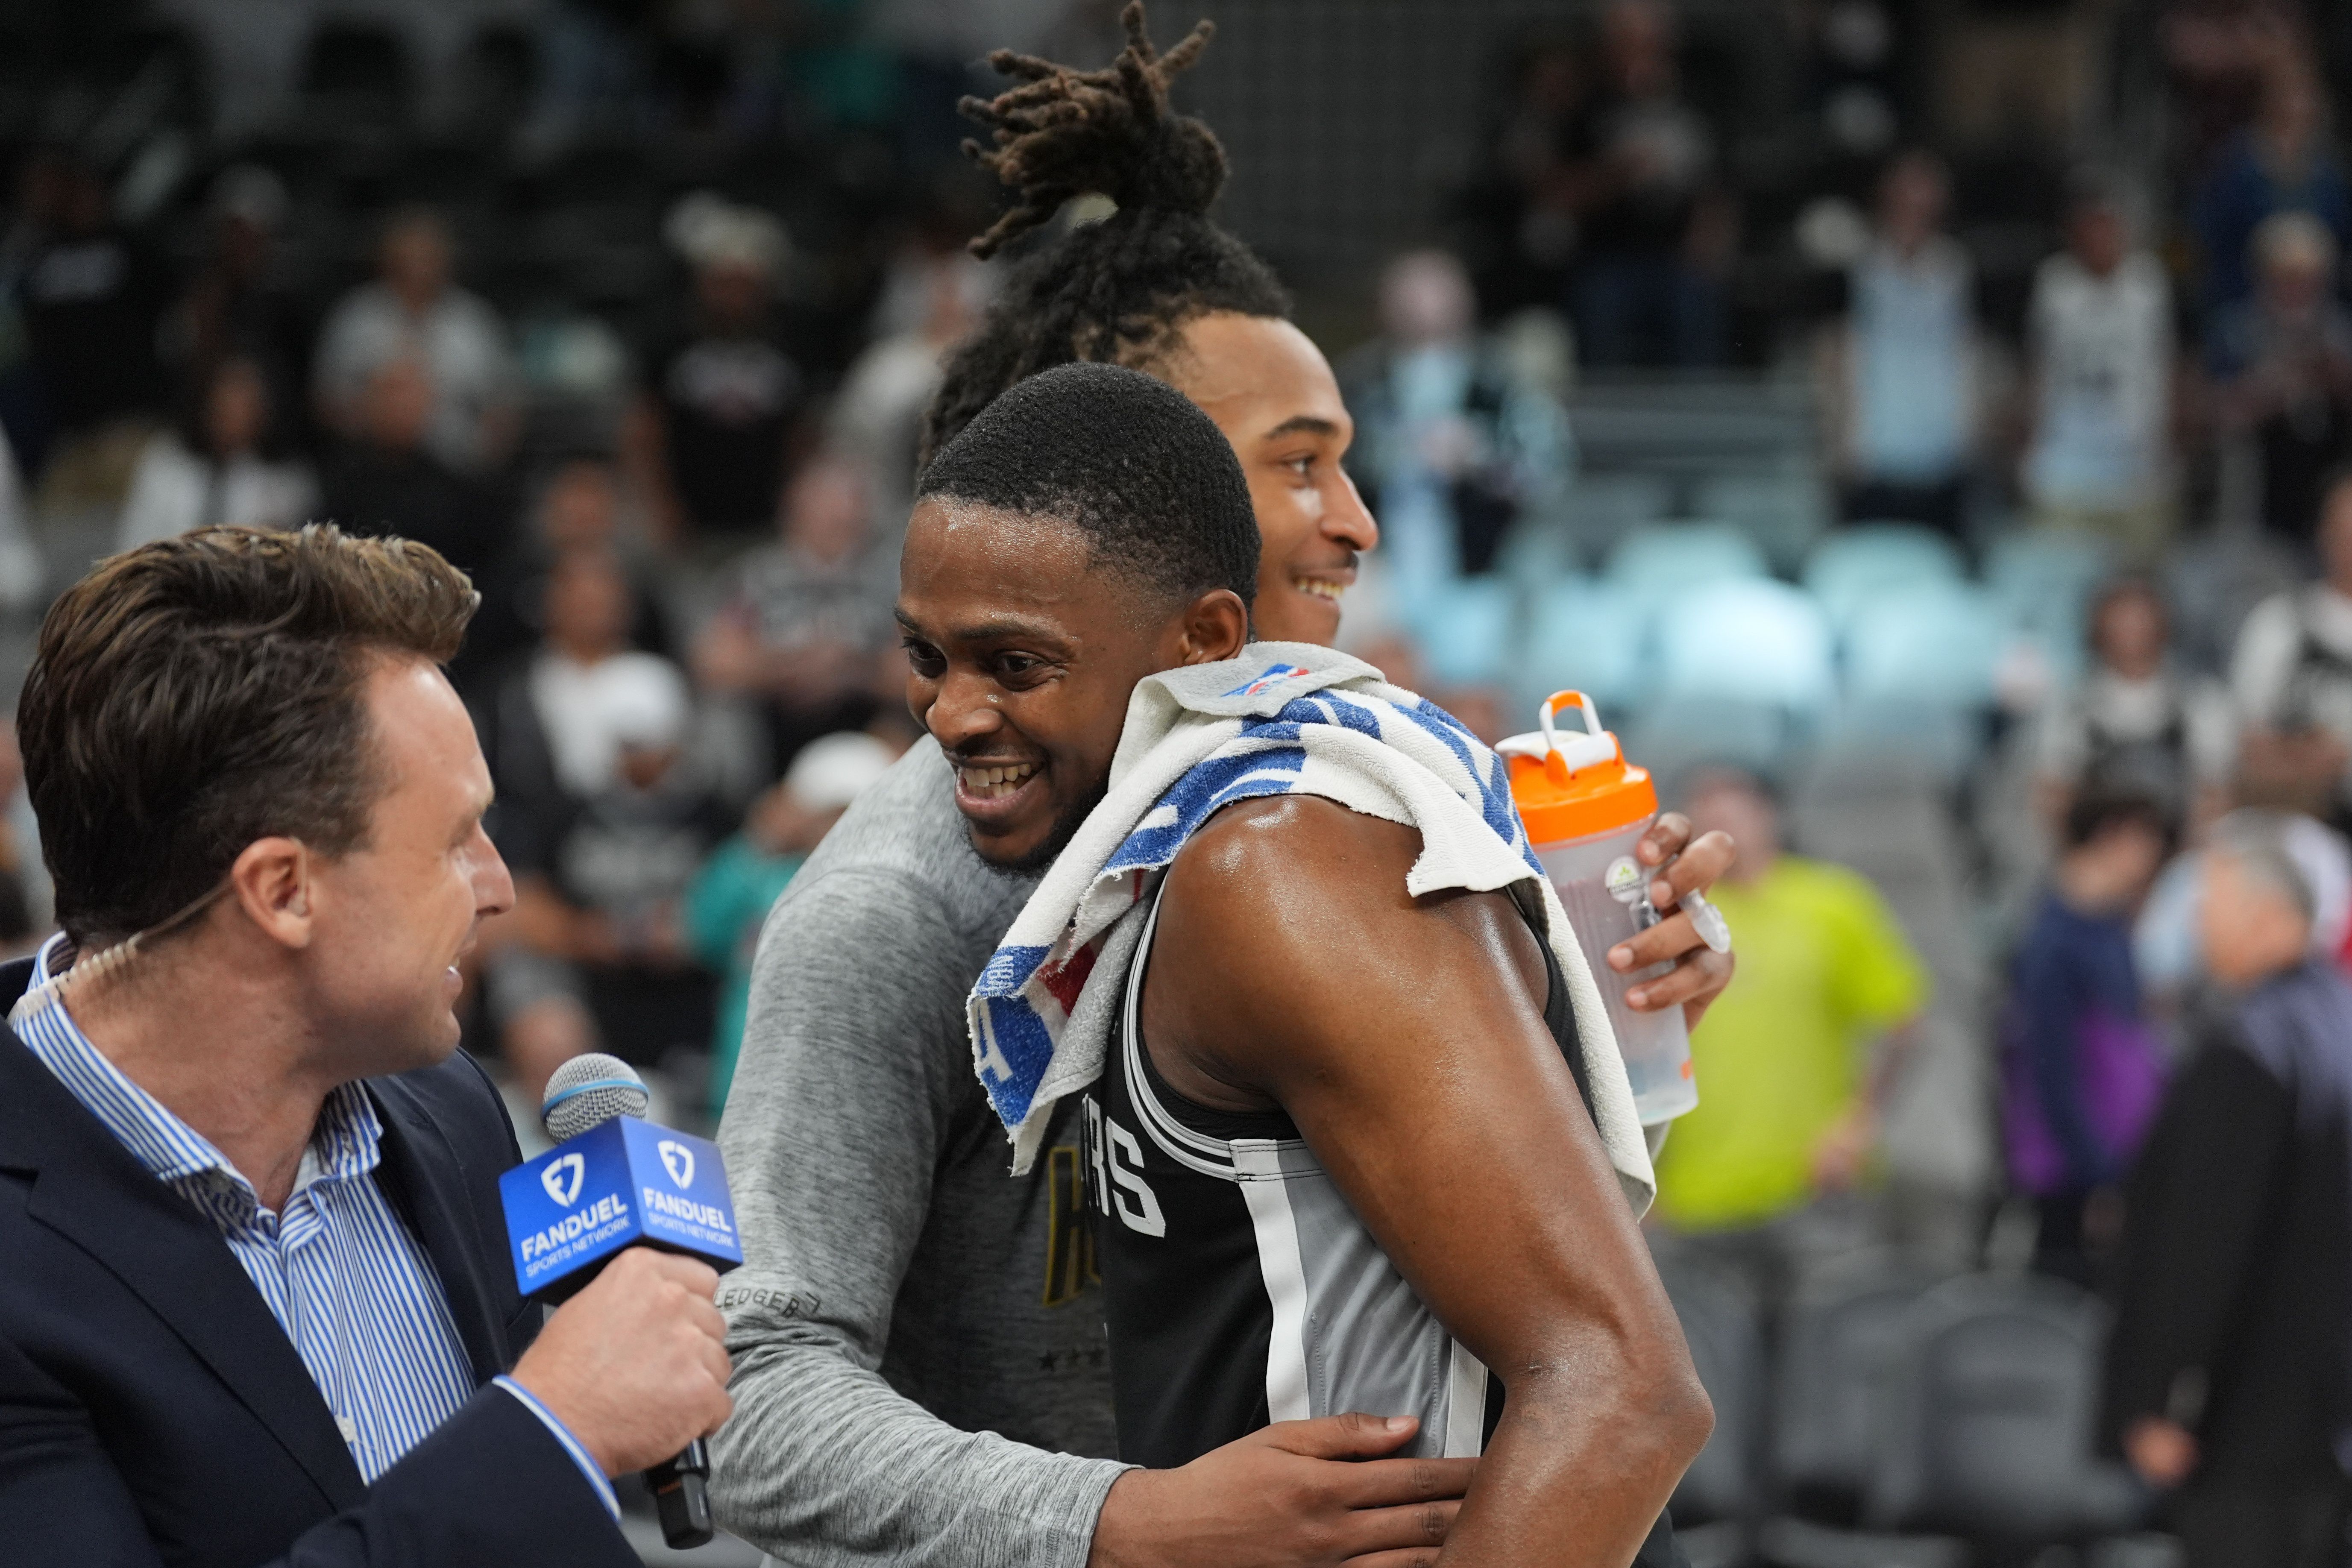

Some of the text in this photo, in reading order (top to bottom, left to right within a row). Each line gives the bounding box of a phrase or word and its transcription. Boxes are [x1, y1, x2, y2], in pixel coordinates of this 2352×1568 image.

[521, 1193, 628, 1262] FANDUEL
[642, 1187, 732, 1233] FANDUEL
[648, 1212, 735, 1249] SPORTS NETWORK
[526, 1215, 631, 1278] SPORTS NETWORK
